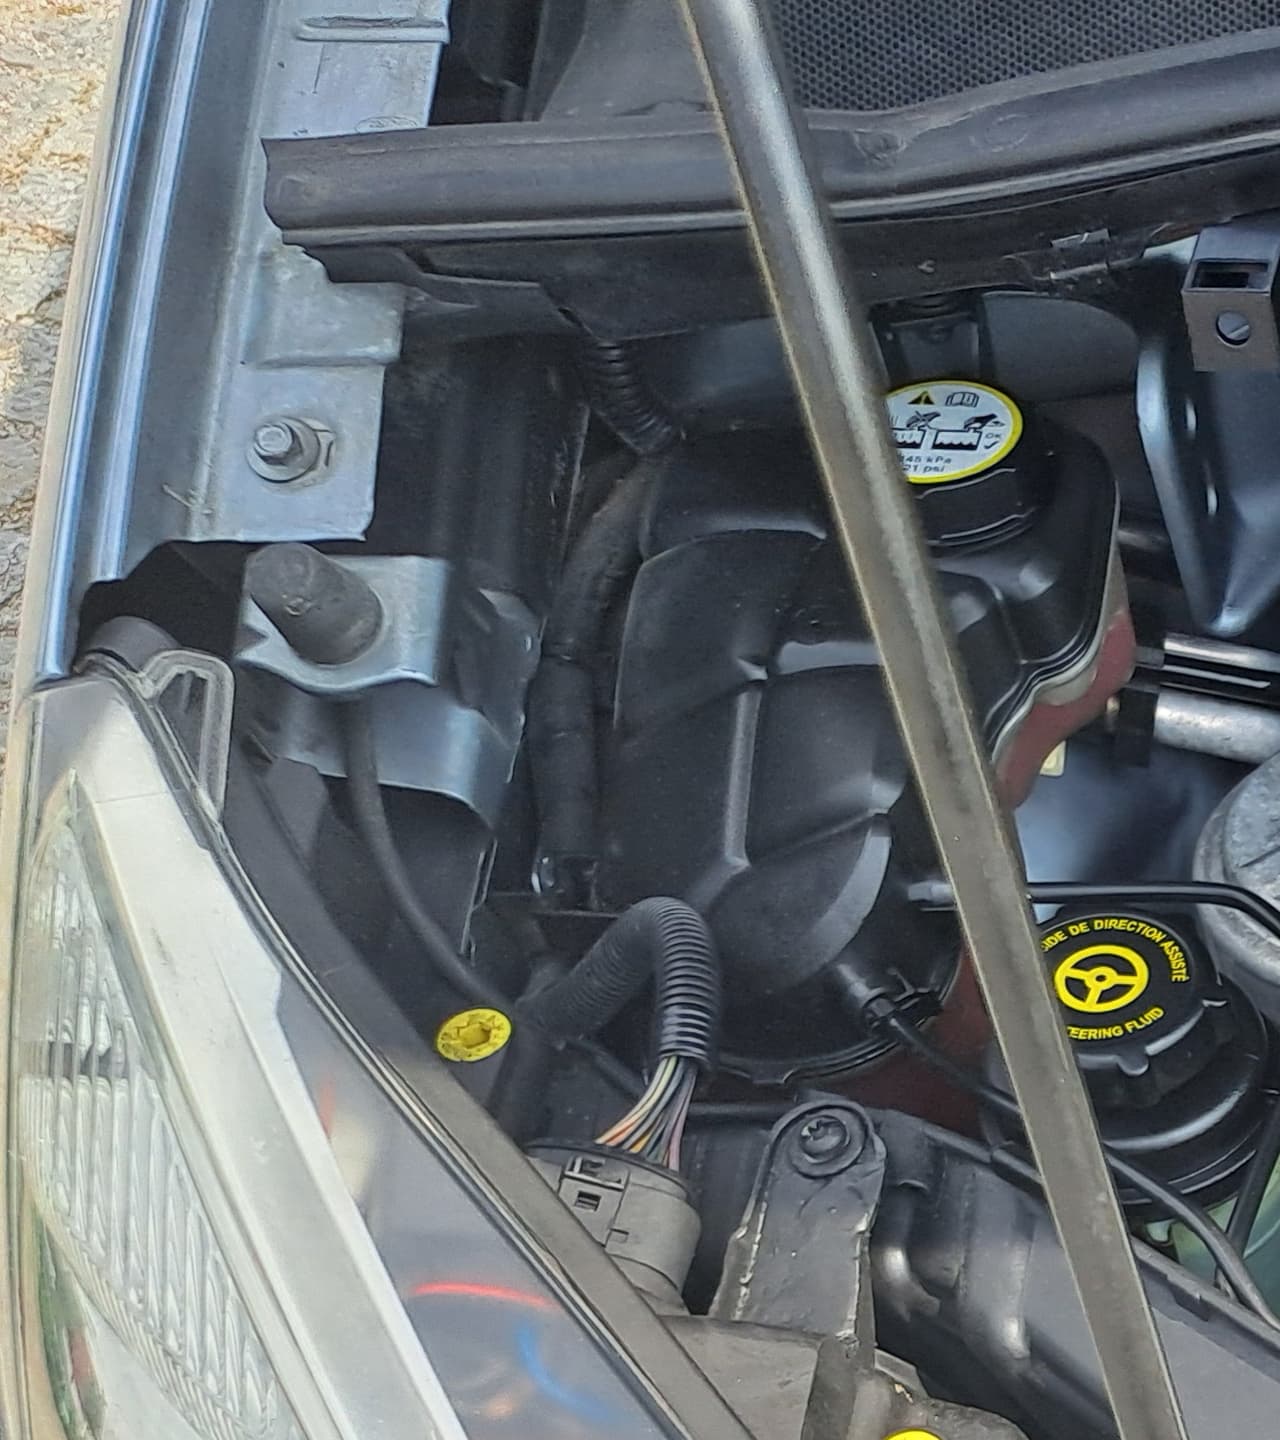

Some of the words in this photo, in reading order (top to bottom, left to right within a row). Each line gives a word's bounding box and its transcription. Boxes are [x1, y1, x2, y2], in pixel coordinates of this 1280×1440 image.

[1068, 922, 1090, 938] DE
[1093, 918, 1167, 944] DIRECTION
[1124, 1006, 1165, 1034] FLUID
